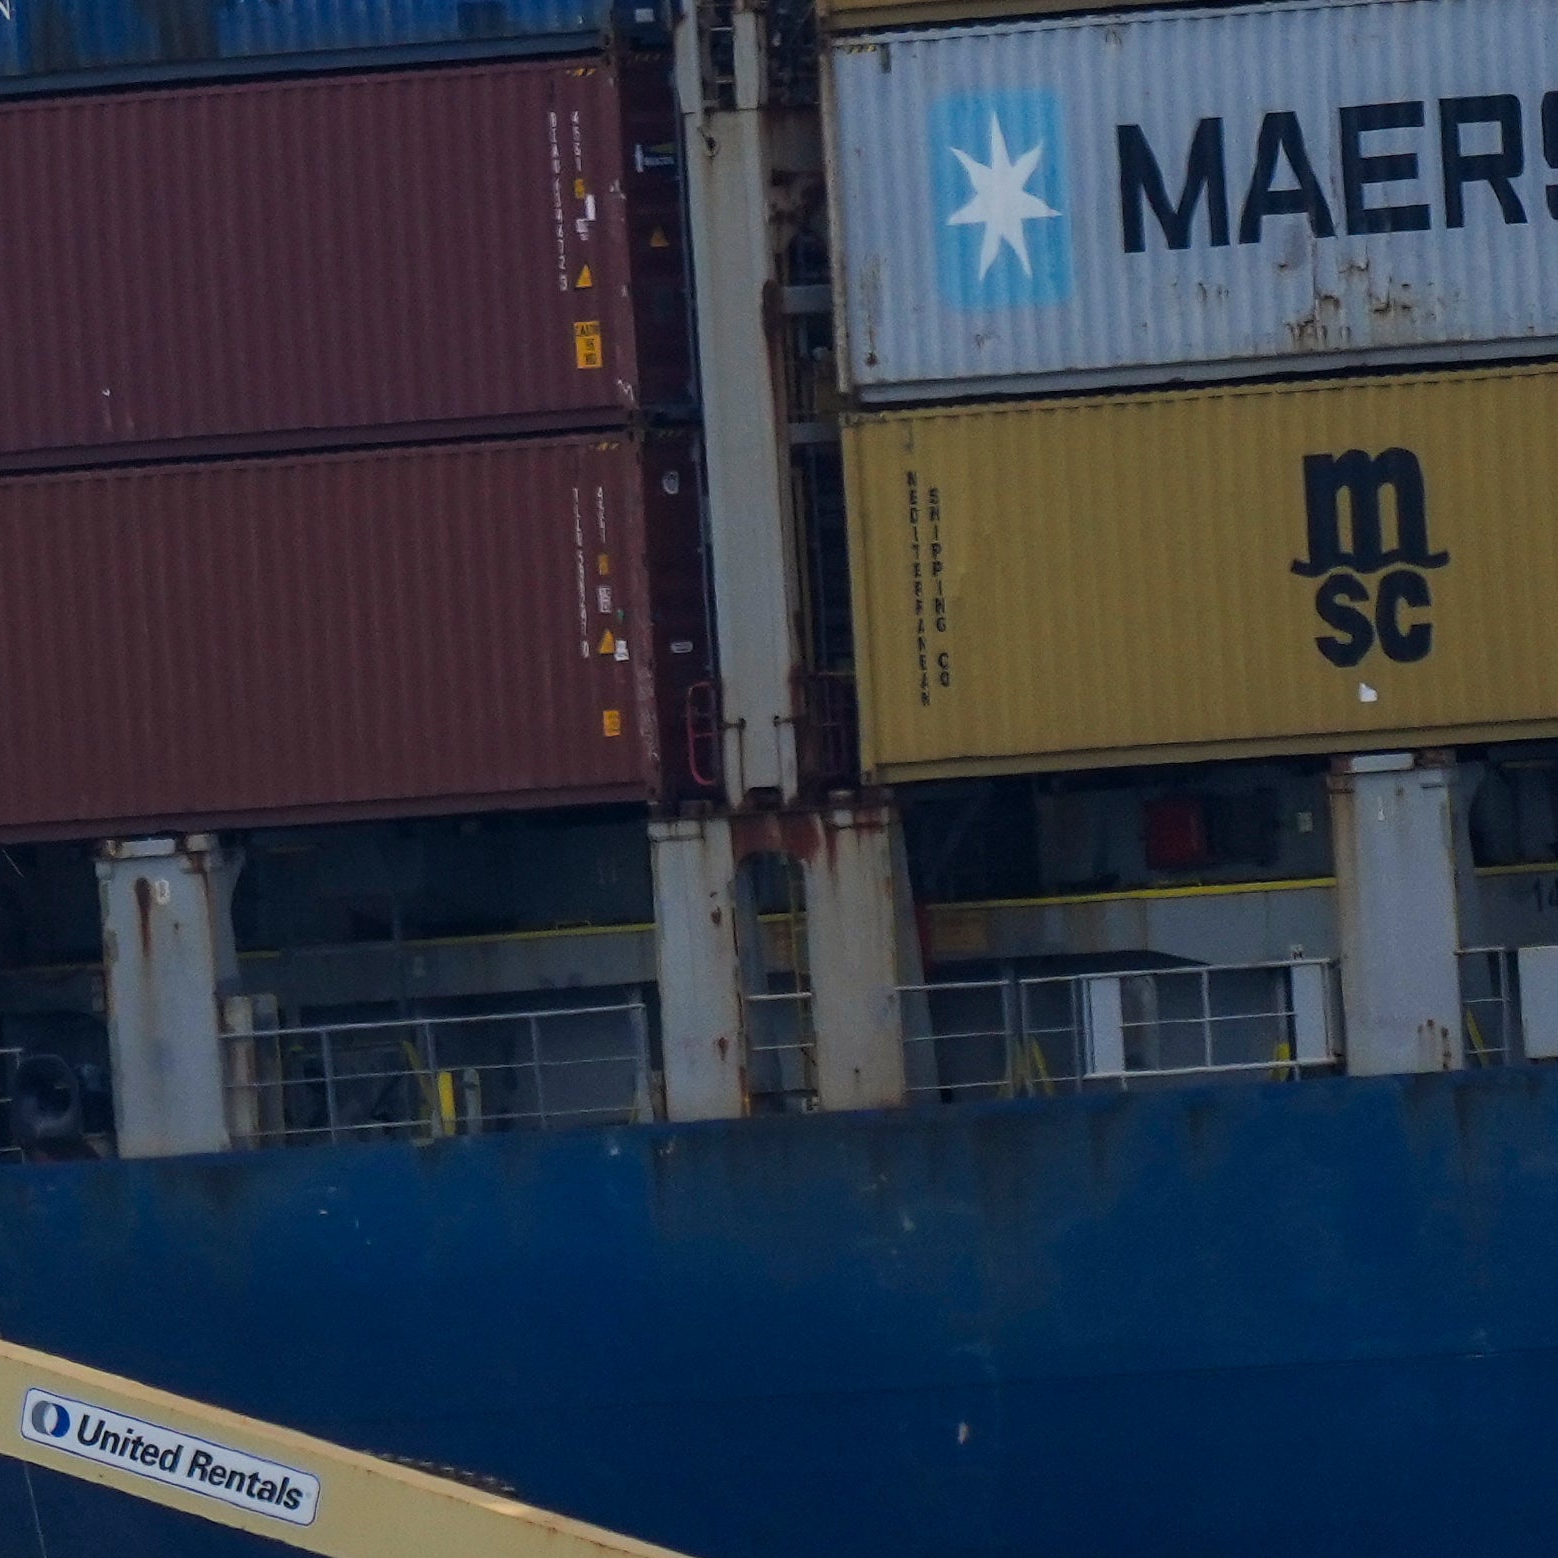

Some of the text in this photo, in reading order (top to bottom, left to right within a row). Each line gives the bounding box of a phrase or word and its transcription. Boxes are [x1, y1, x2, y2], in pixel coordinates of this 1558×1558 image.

[1116, 91, 1558, 254] MAER
[76, 1414, 304, 1510] United Rentals
